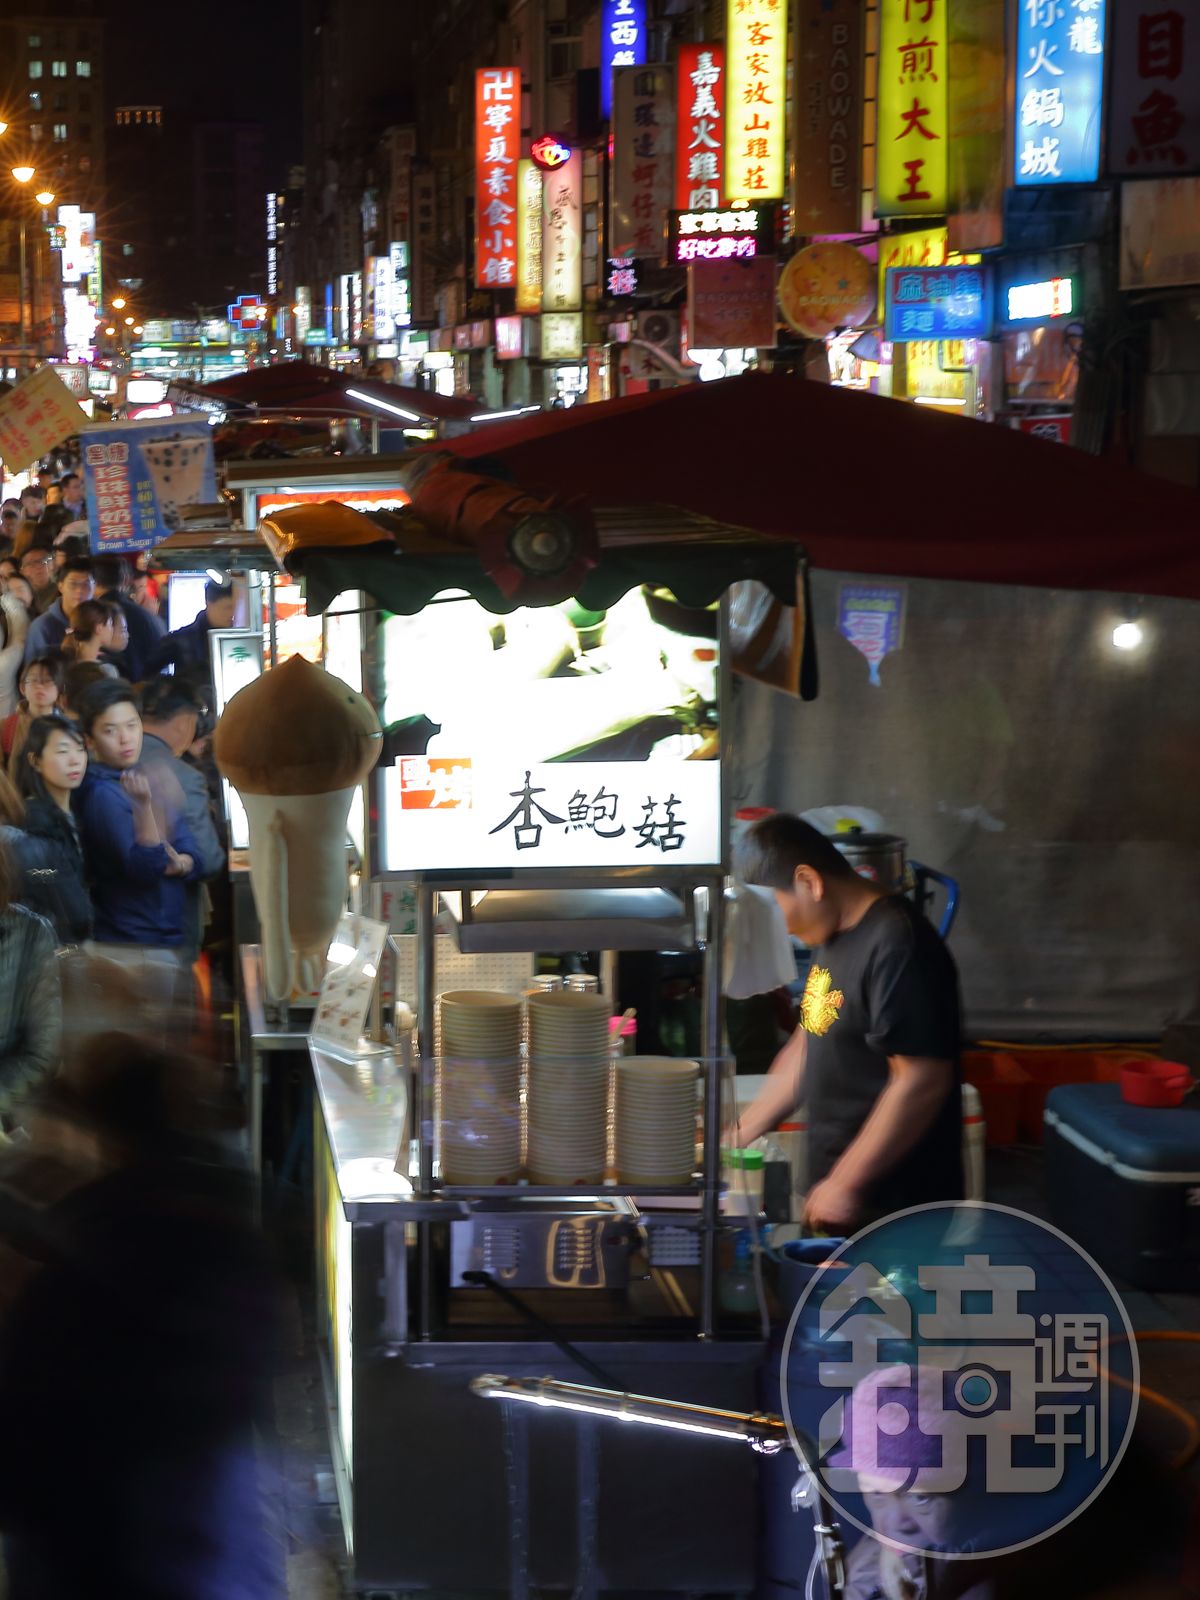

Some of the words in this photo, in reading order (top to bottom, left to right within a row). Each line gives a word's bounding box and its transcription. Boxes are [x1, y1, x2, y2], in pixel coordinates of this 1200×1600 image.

[1067, 0, 1105, 54] 龍
[488, 770, 687, 852] 杏鮑菇
